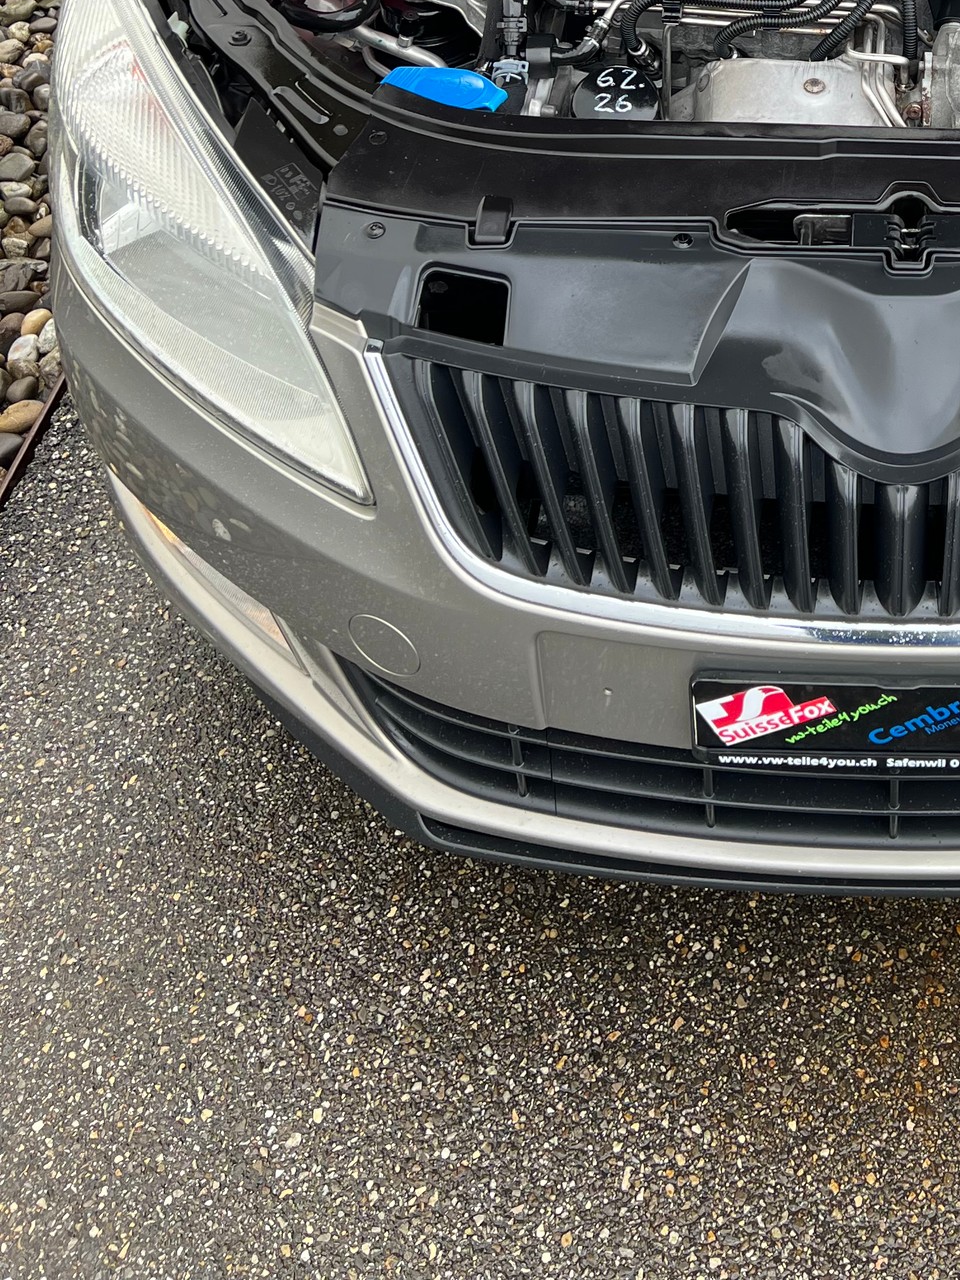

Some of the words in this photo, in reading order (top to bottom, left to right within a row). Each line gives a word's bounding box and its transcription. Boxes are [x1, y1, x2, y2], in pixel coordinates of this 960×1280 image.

[594, 93, 632, 112] 26
[718, 755, 877, 768] www.vw-teile4you.ch
[886, 758, 946, 768] Safenwil
